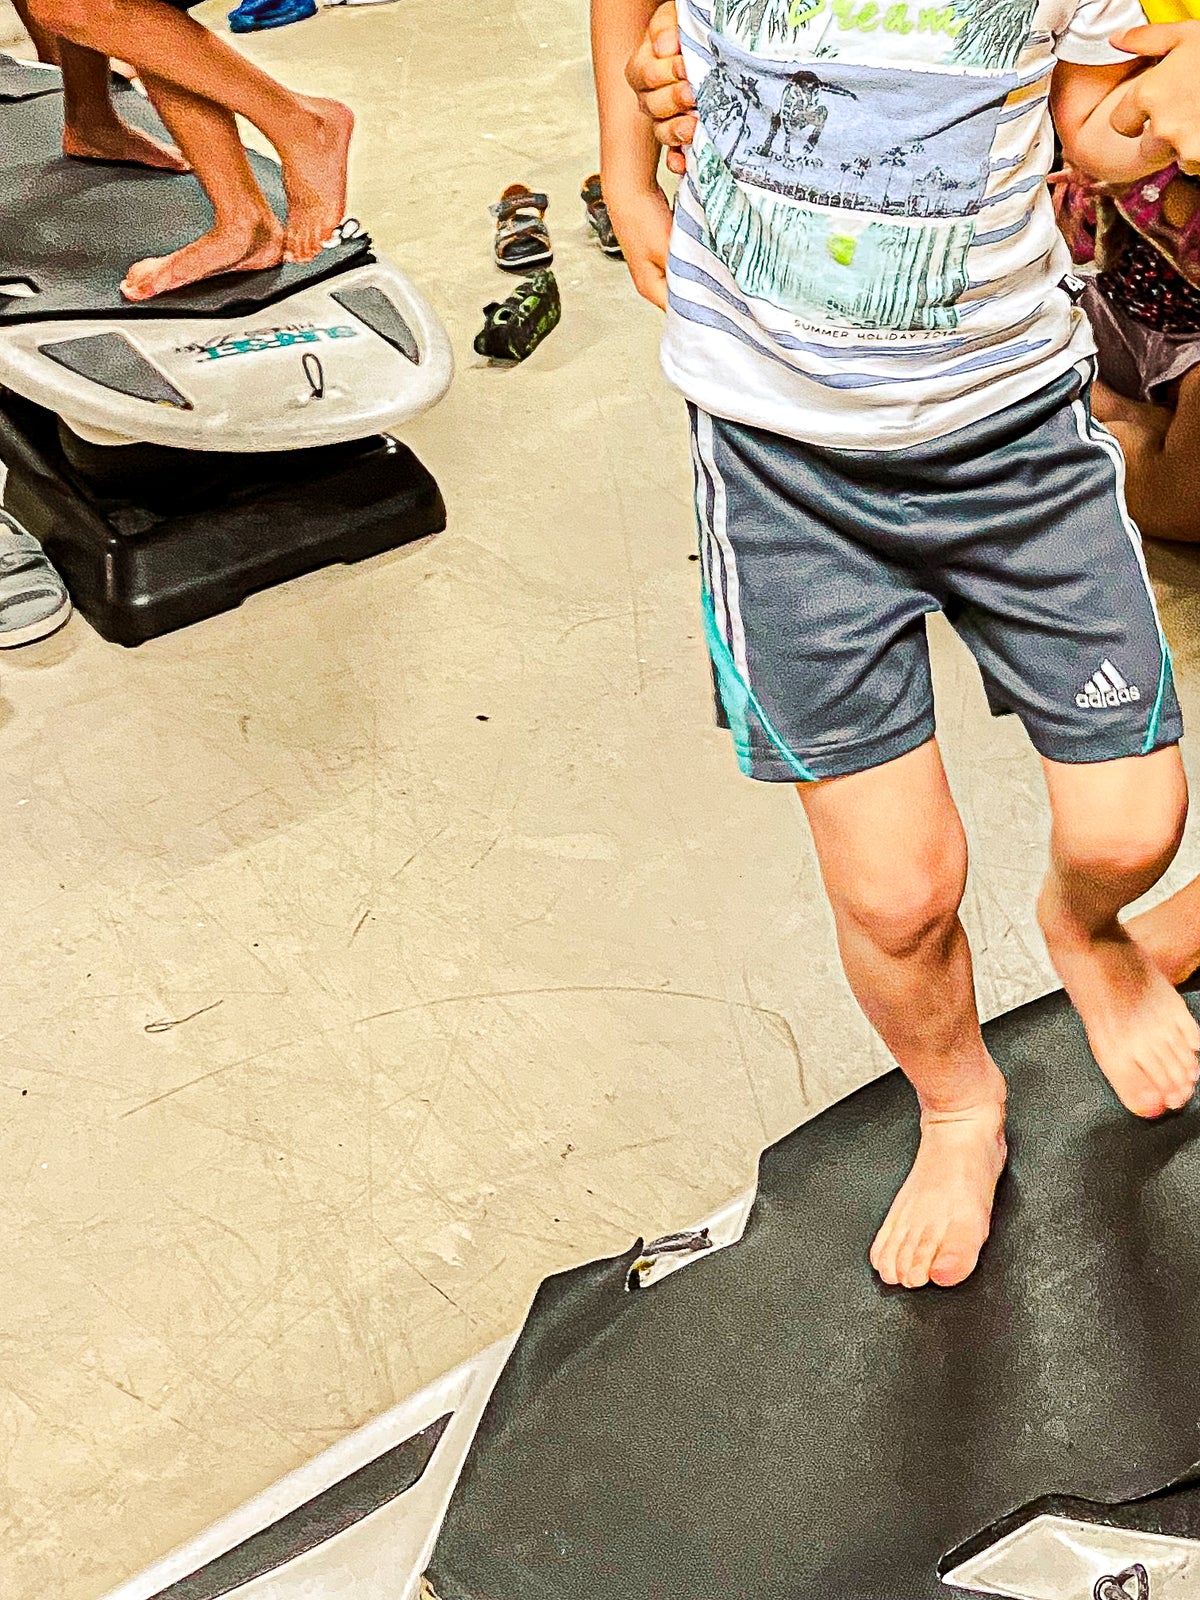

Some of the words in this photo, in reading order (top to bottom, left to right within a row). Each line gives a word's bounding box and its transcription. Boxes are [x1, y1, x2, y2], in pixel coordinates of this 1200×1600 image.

[793, 319, 849, 338] SUMMER
[857, 331, 916, 341] HOLIDAY
[1075, 685, 1141, 709] adidas
